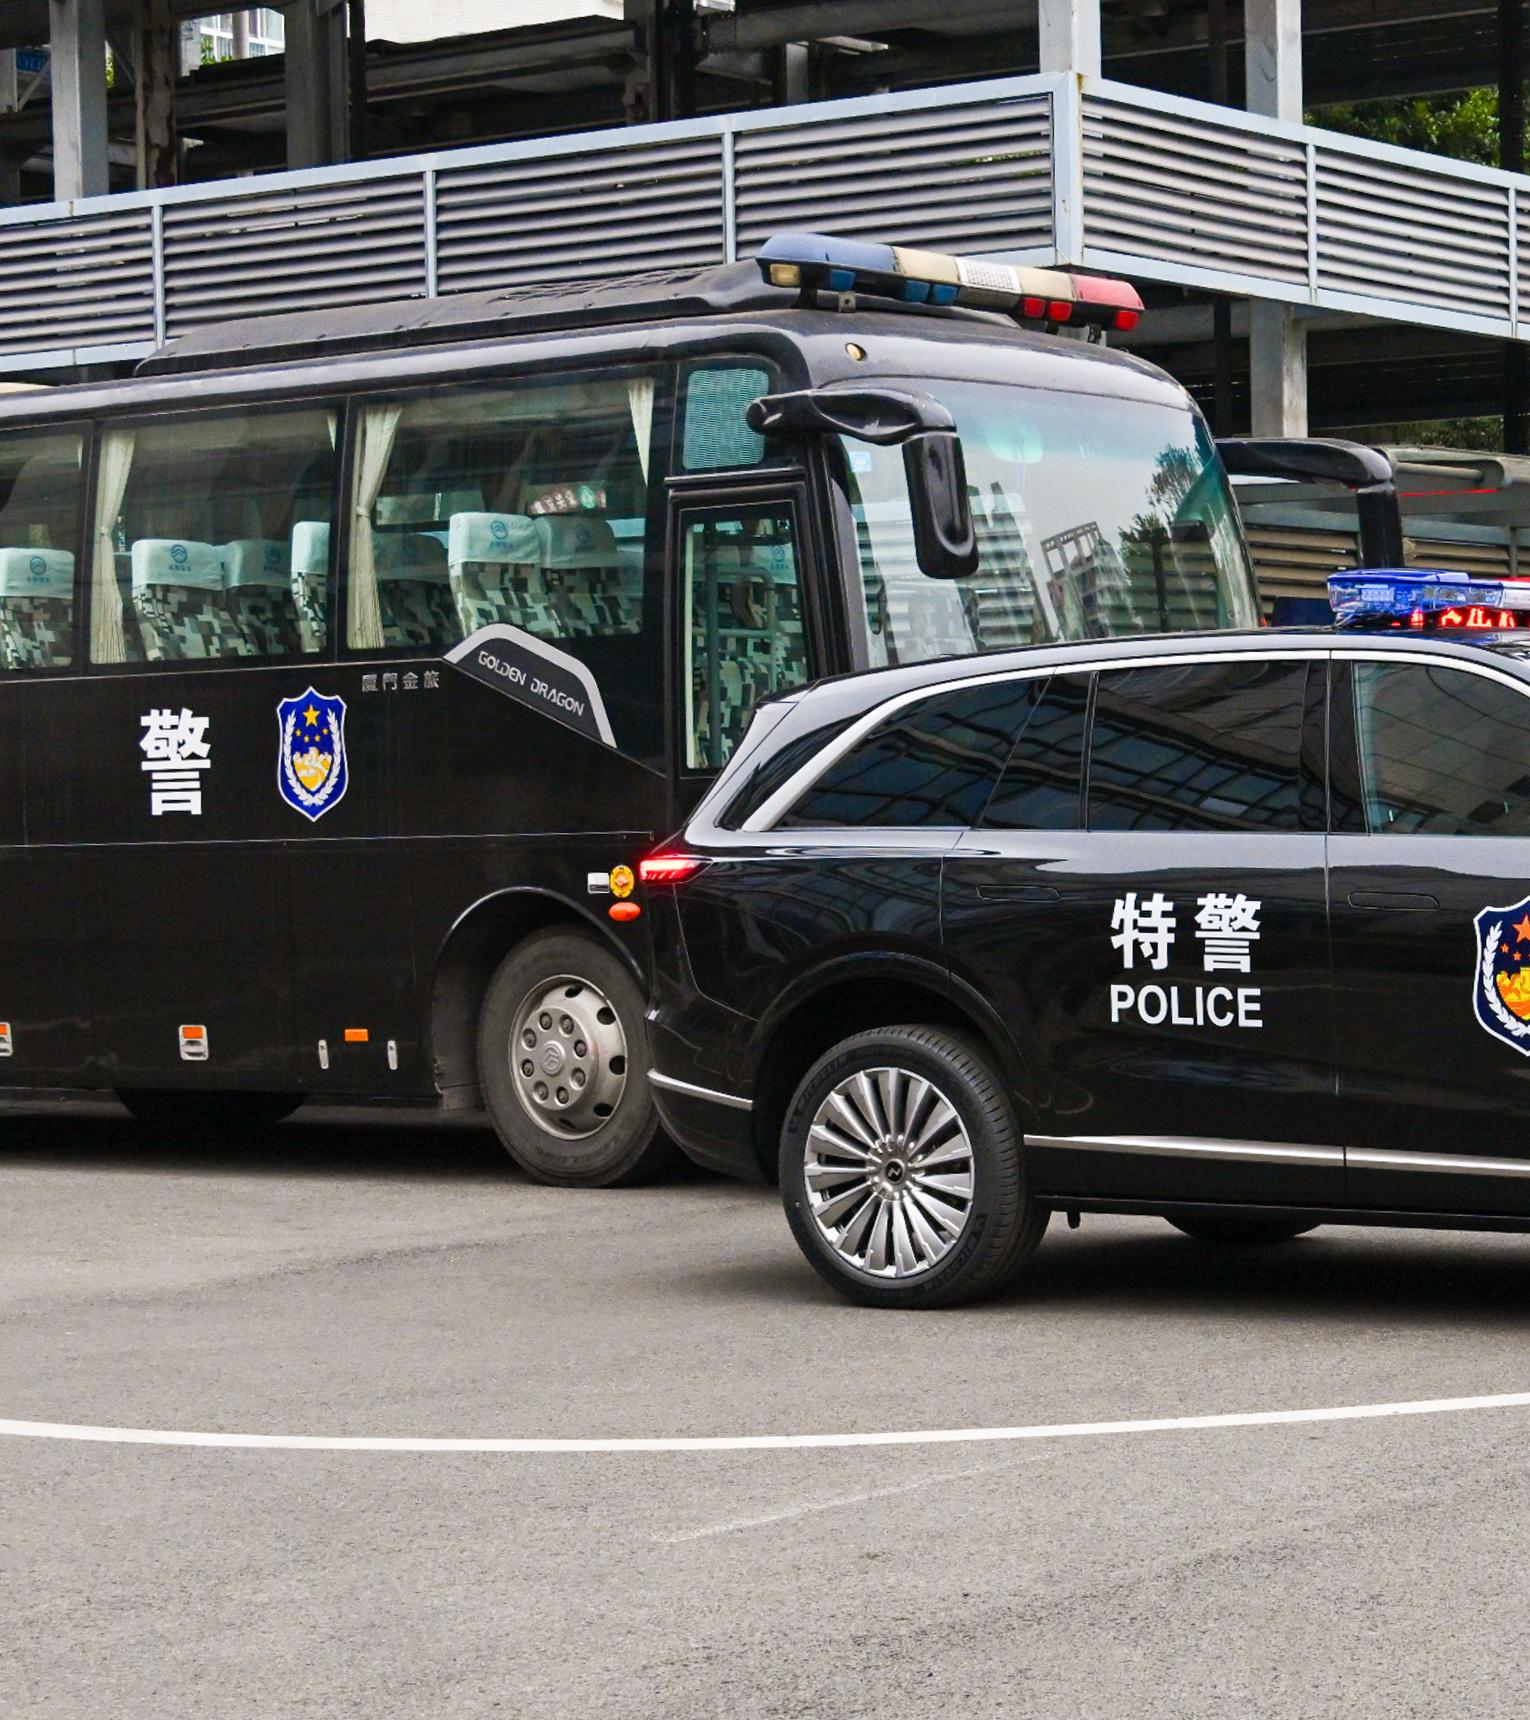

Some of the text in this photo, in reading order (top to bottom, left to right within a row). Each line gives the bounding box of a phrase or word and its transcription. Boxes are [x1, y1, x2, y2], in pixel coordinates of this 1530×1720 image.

[478, 650, 586, 717] GOLDEN DRAGON
[139, 707, 212, 816] 警
[1110, 892, 1263, 973] 特警
[1110, 983, 1264, 1028] POLICE
